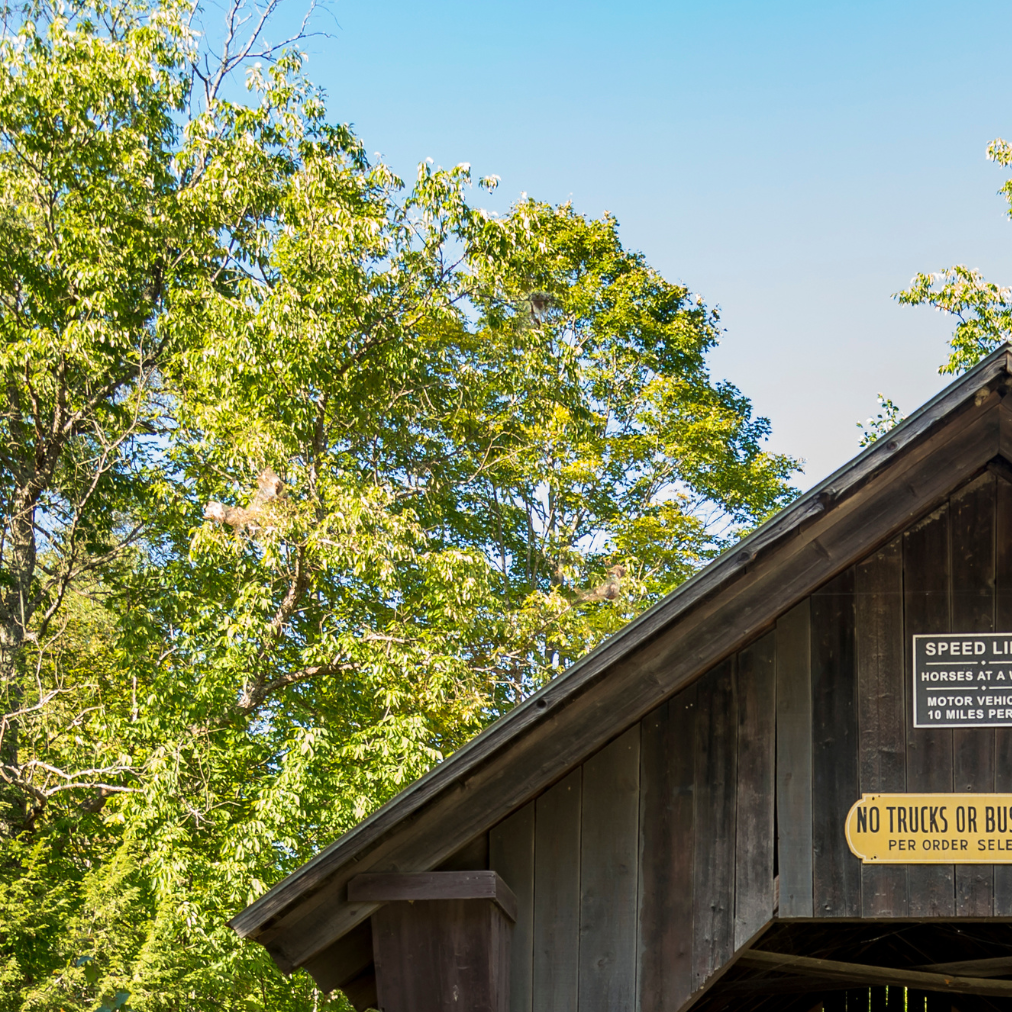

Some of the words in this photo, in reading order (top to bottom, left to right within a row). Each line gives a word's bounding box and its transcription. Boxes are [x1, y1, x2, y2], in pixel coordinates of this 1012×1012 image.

[925, 641, 986, 656] SPEED
[921, 671, 973, 682] HORSES
[977, 670, 993, 681] AT
[996, 670, 1006, 681] A
[927, 696, 973, 707] MOTOR
[928, 709, 942, 720] 10
[946, 709, 984, 720] MILES
[856, 806, 881, 834] NO
[886, 806, 948, 834] TRUCKS
[956, 806, 977, 834] OR
[888, 839, 917, 851] PER
[922, 839, 969, 851] ORDER
